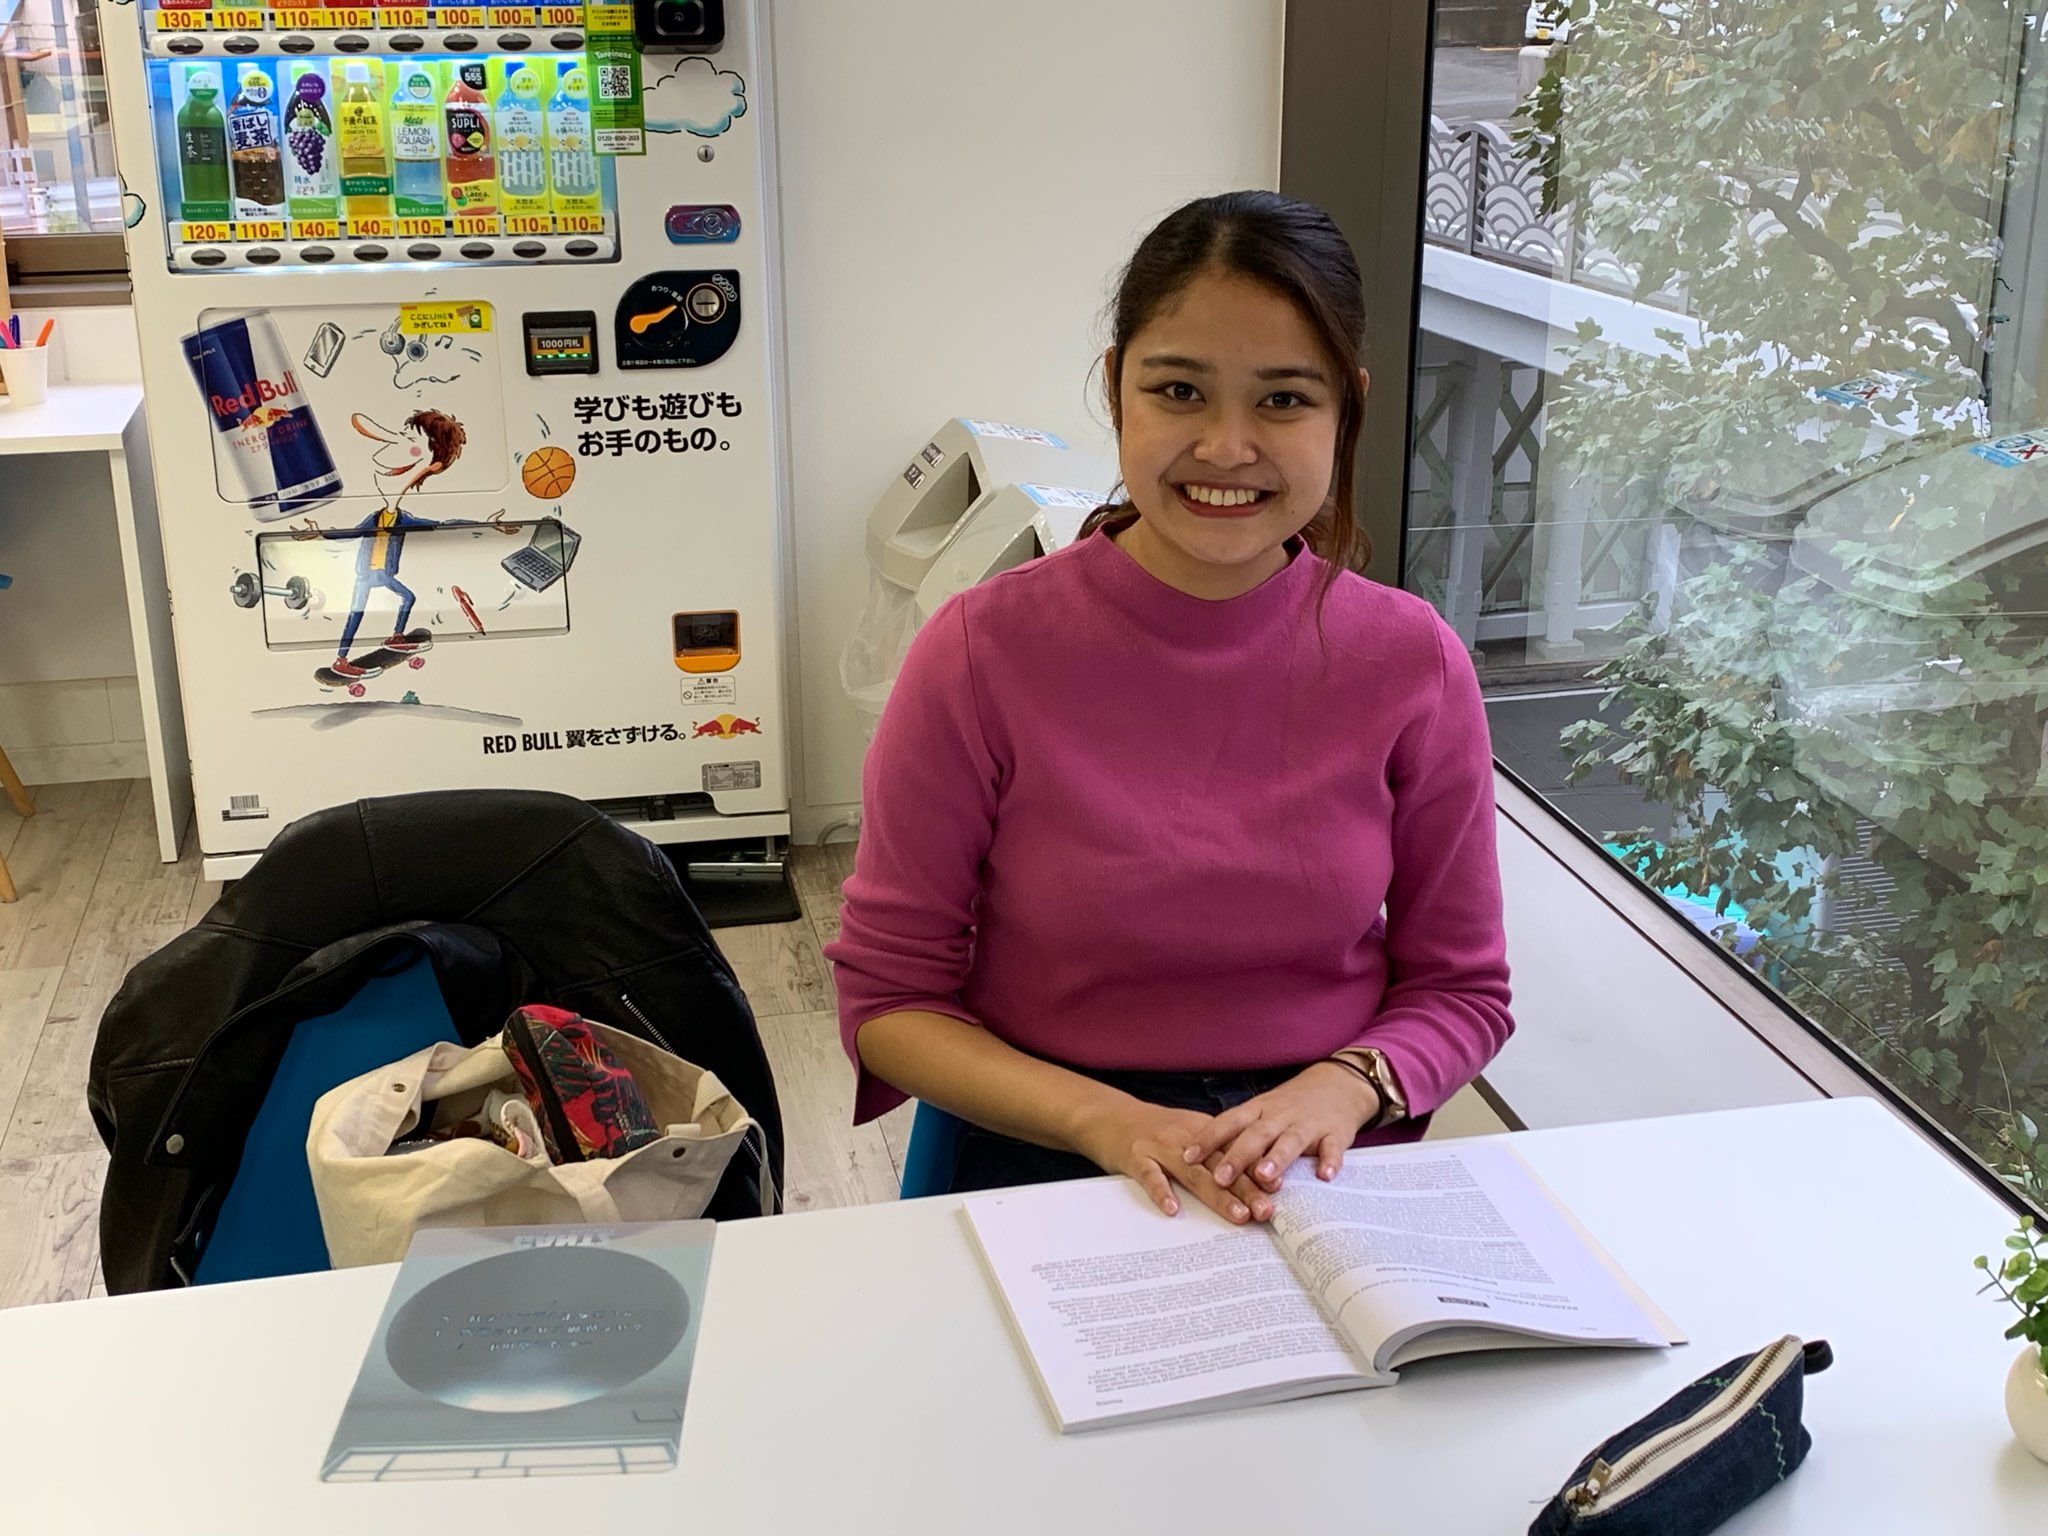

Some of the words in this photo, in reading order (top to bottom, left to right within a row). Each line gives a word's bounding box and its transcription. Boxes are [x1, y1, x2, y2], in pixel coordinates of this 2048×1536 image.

[162, 12, 202, 27] 130円
[218, 11, 257, 27] 110円
[280, 11, 319, 27] 110円
[329, 11, 368, 26] 110円
[385, 10, 423, 26] 110円
[442, 9, 480, 24] 100円
[493, 9, 532, 24] 100円
[547, 8, 584, 24] 100円
[452, 118, 480, 129] SUPLI
[397, 127, 430, 136] LEMON
[396, 136, 433, 145] SQUASH
[241, 223, 280, 238] 110円
[297, 222, 335, 237] 140円
[353, 220, 391, 235] 140円
[403, 219, 441, 234] 110円
[458, 218, 496, 233] 110円
[512, 217, 549, 232] 110円
[562, 216, 598, 231] 110円
[187, 224, 226, 239] 120円
[541, 338, 581, 348] 1000円札
[210, 383, 257, 417] Red
[255, 370, 299, 403] Bull
[574, 391, 743, 424] 学びも遊びも
[577, 427, 731, 457] お手のもの。
[482, 735, 517, 754] RED
[522, 731, 563, 752] BULL
[565, 723, 686, 748] 翼をさずける。
